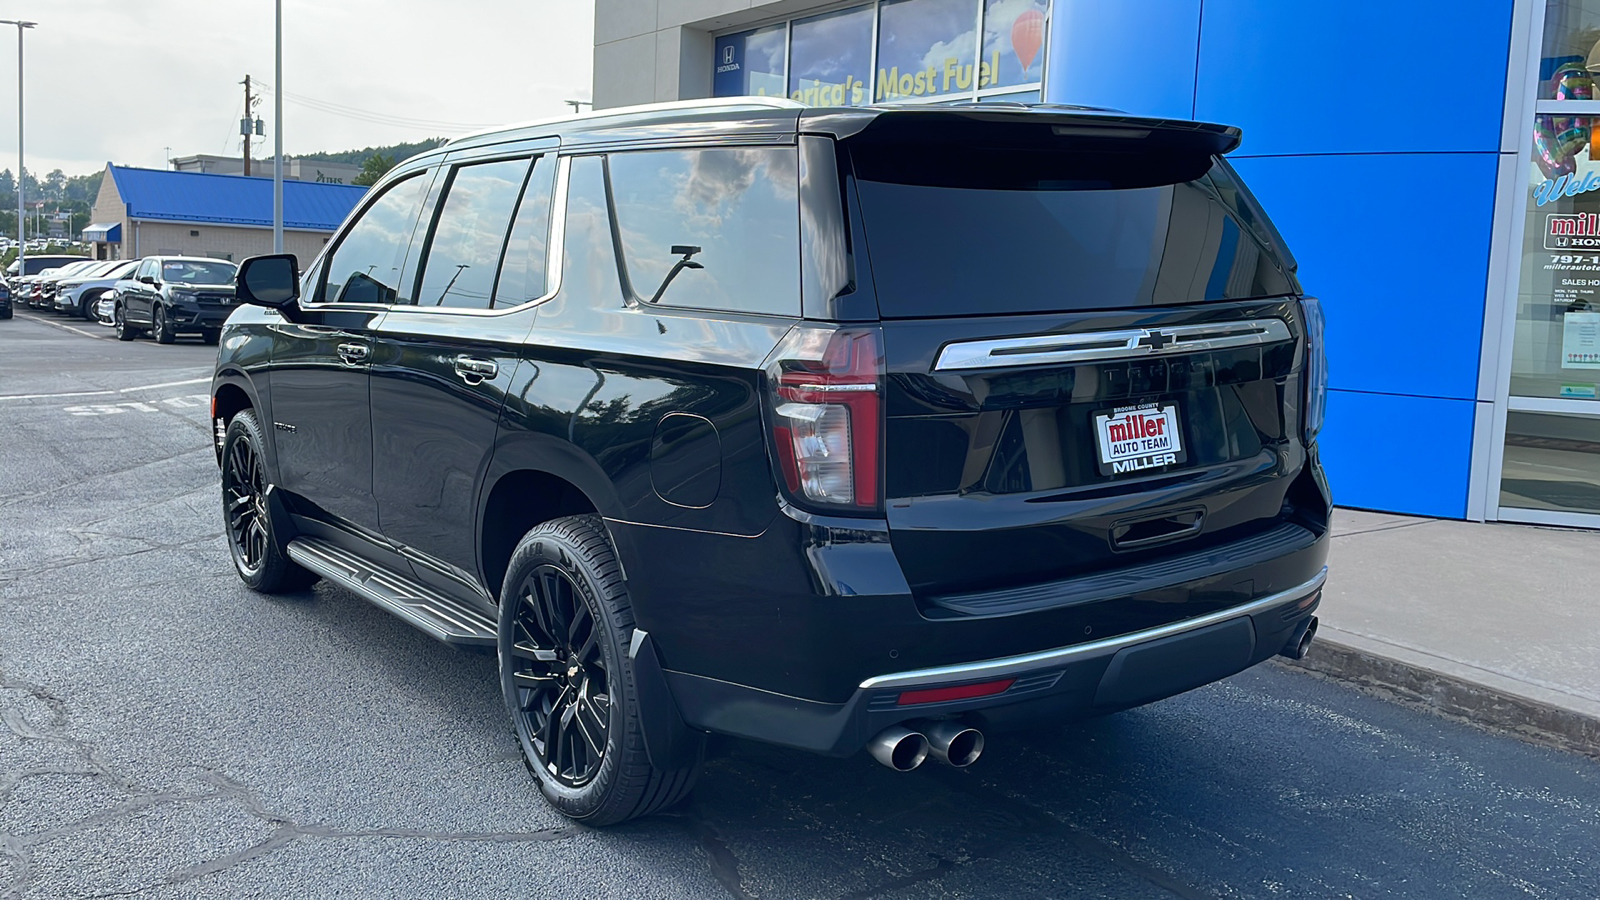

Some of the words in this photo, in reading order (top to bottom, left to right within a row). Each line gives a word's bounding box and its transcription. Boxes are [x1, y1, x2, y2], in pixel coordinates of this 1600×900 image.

[717, 63, 740, 73] HONDA
[757, 75, 863, 107] erica's
[876, 66, 937, 100] Most
[943, 50, 1000, 92] Fuel
[1533, 171, 1600, 207] Welc
[1550, 212, 1600, 236] mil
[1561, 278, 1587, 286] SALES
[1137, 402, 1159, 410] COUNTY
[1109, 414, 1165, 443] miller
[1113, 441, 1139, 455] AUTO
[1141, 437, 1168, 450] TEAM
[1112, 453, 1177, 474] MILLER
